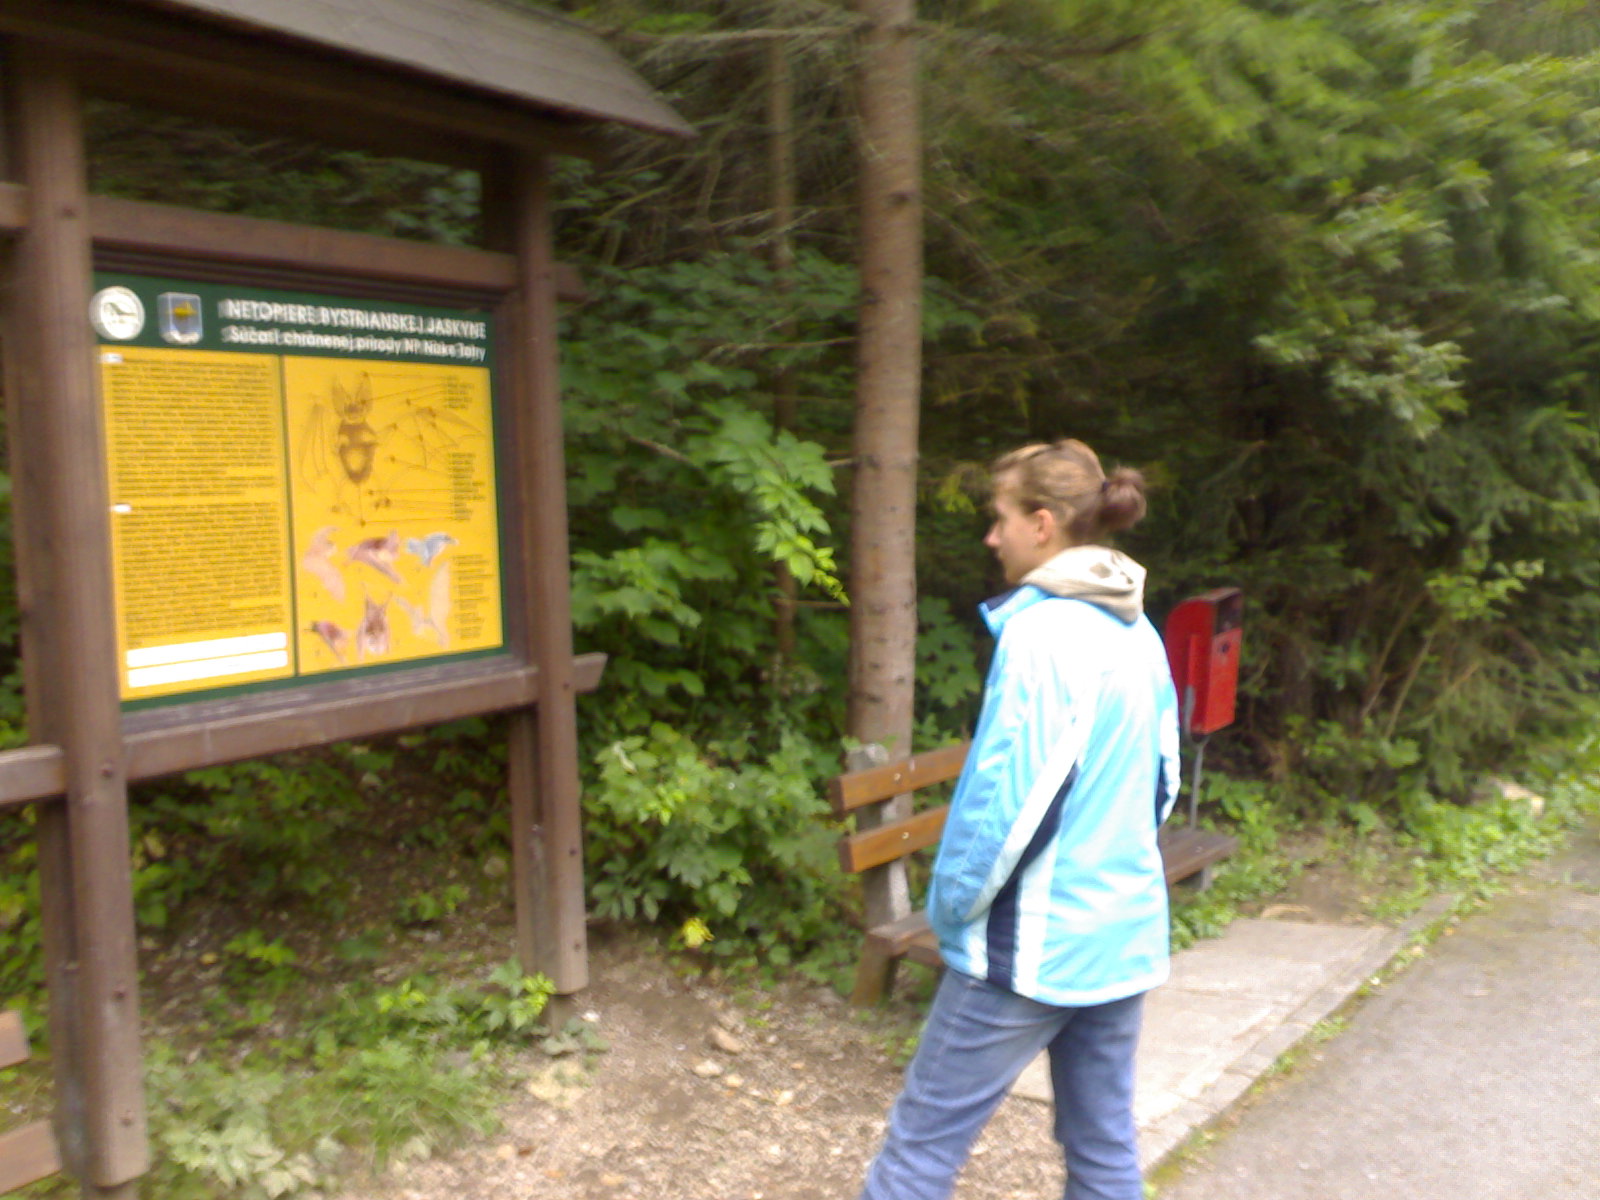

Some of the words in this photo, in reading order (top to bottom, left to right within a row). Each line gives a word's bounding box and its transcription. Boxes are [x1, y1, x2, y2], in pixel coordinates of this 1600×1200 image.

[218, 299, 316, 325] NETOPIERE
[318, 306, 423, 334] BYSTRIANSKEJ
[426, 317, 486, 339] JASKYNE
